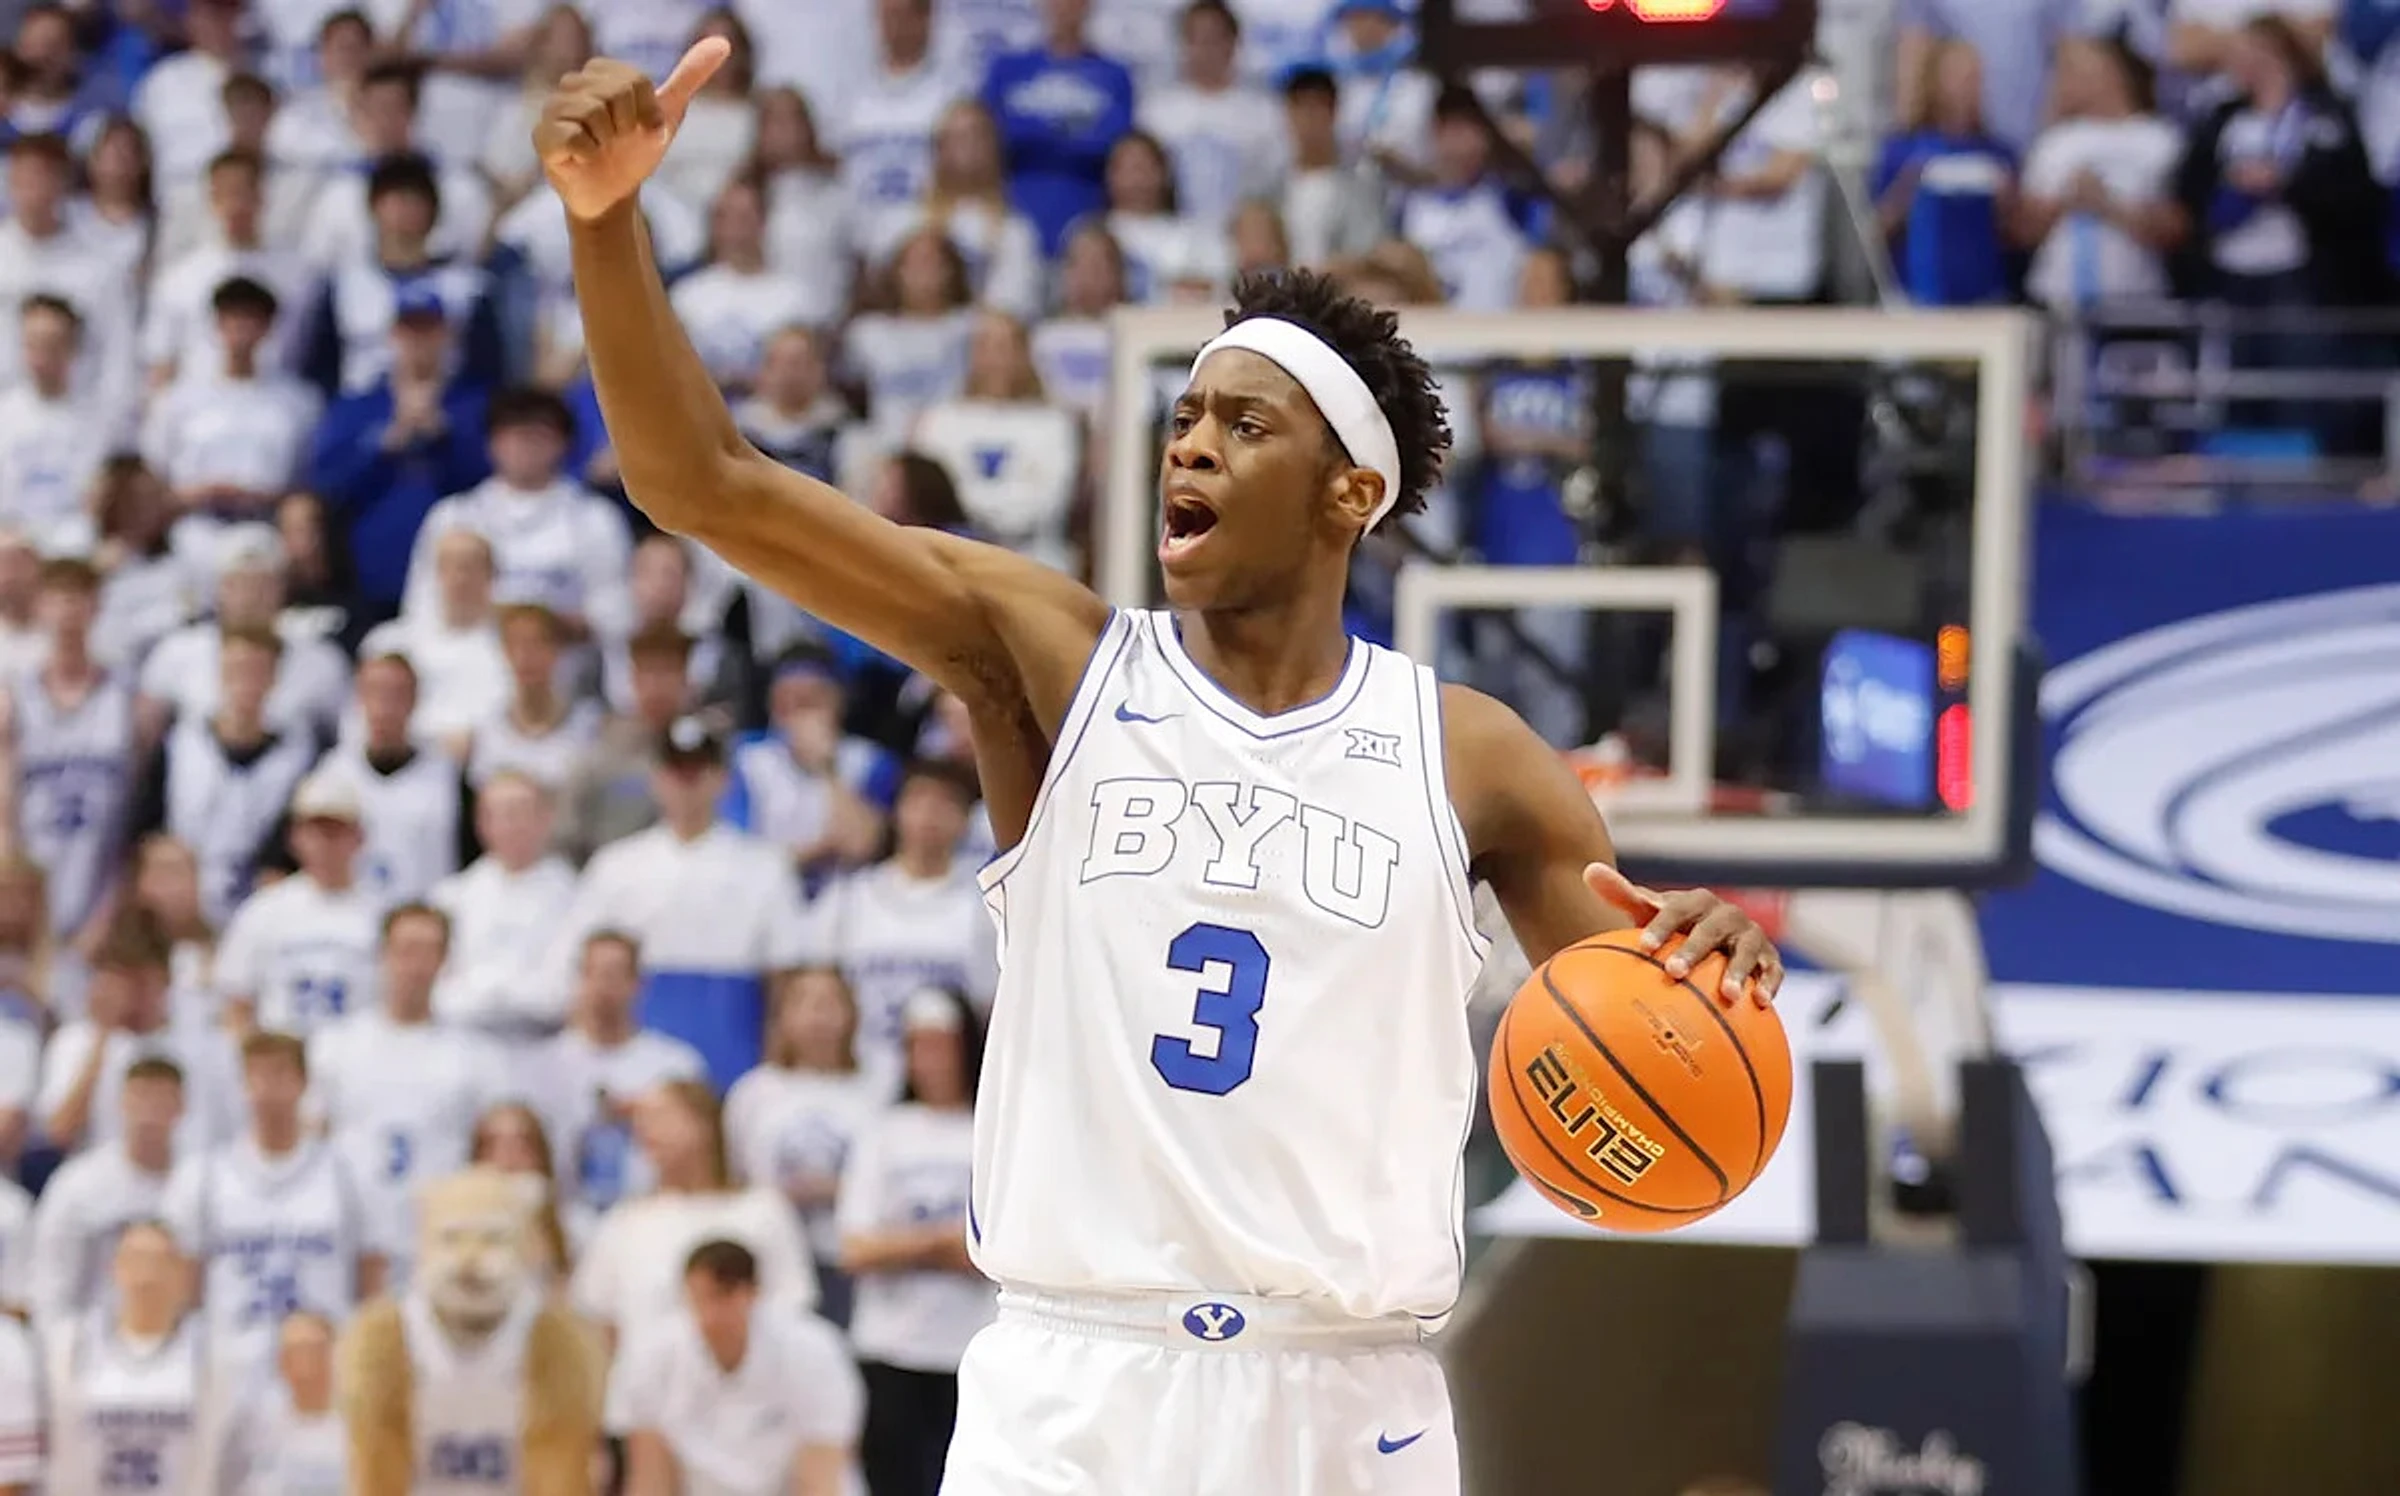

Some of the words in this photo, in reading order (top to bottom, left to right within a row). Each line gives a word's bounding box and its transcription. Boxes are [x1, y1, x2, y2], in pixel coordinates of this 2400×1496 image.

[1080, 777, 1400, 929] BYU
[1150, 921, 1271, 1096] 3
[1524, 1045, 1657, 1187] ELITE
[1189, 1303, 1239, 1339] Y
